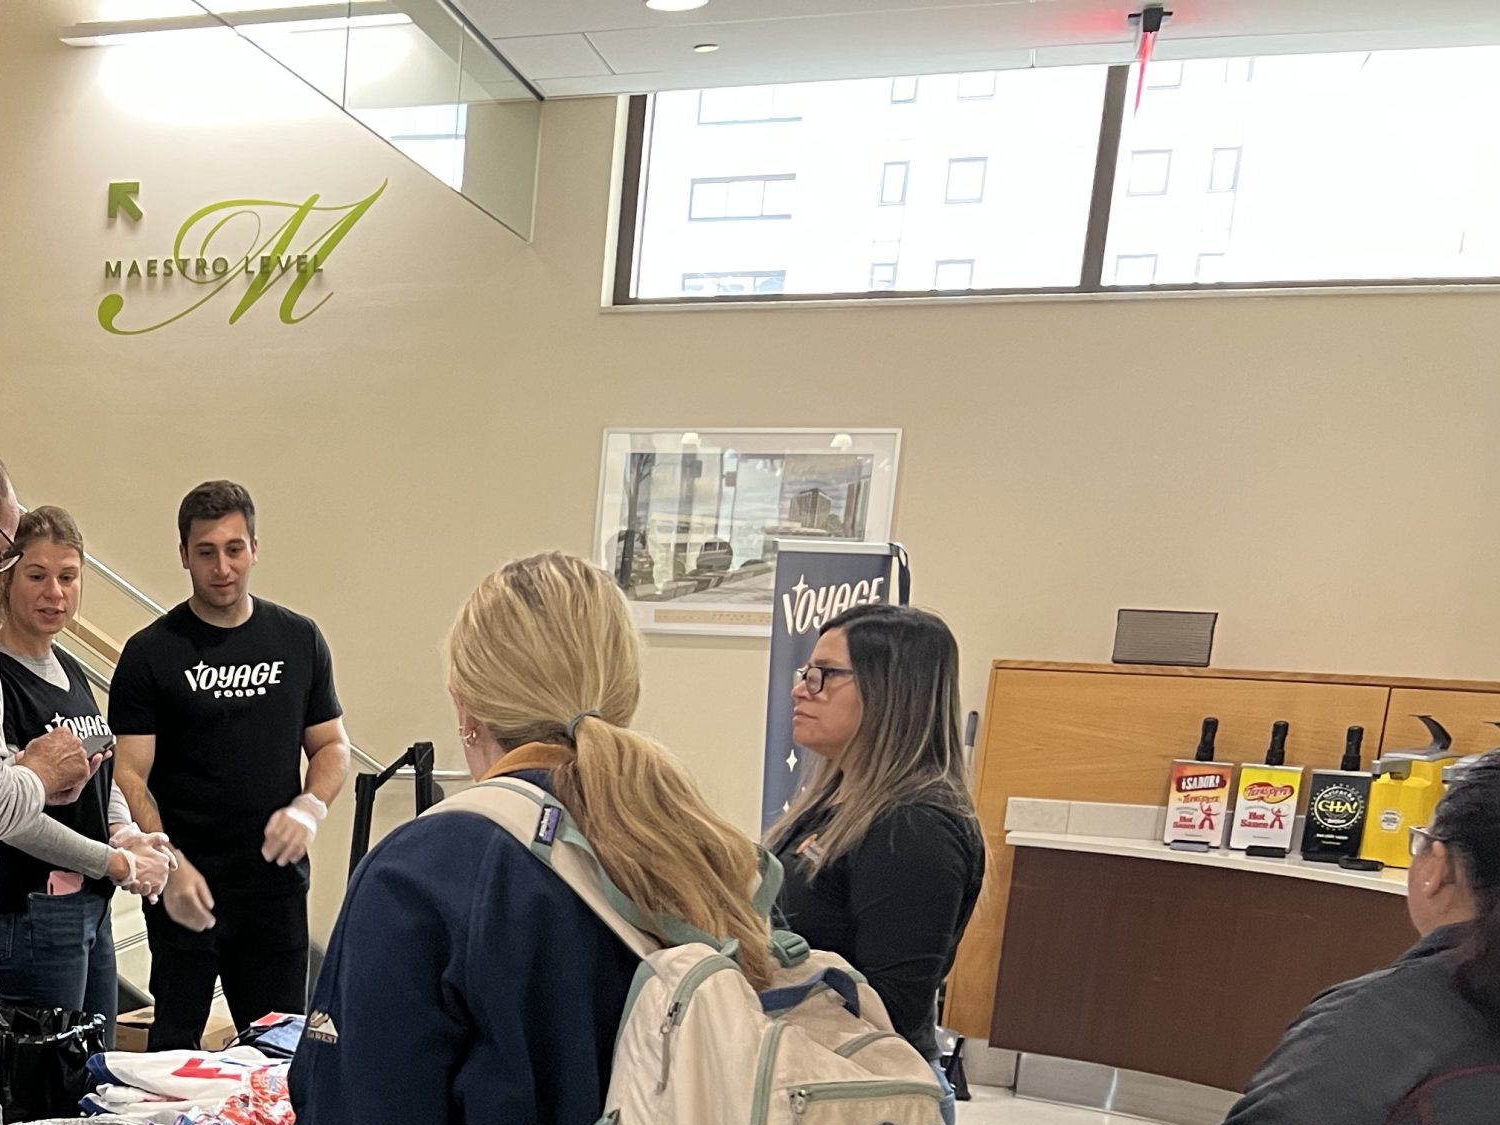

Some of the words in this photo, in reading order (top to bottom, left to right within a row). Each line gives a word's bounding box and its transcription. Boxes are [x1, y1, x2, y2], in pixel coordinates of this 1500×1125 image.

[105, 257, 229, 279] MAESTRO
[244, 254, 324, 275] LEVEL
[184, 660, 285, 692] VOYAGE
[214, 687, 266, 699] FOODS
